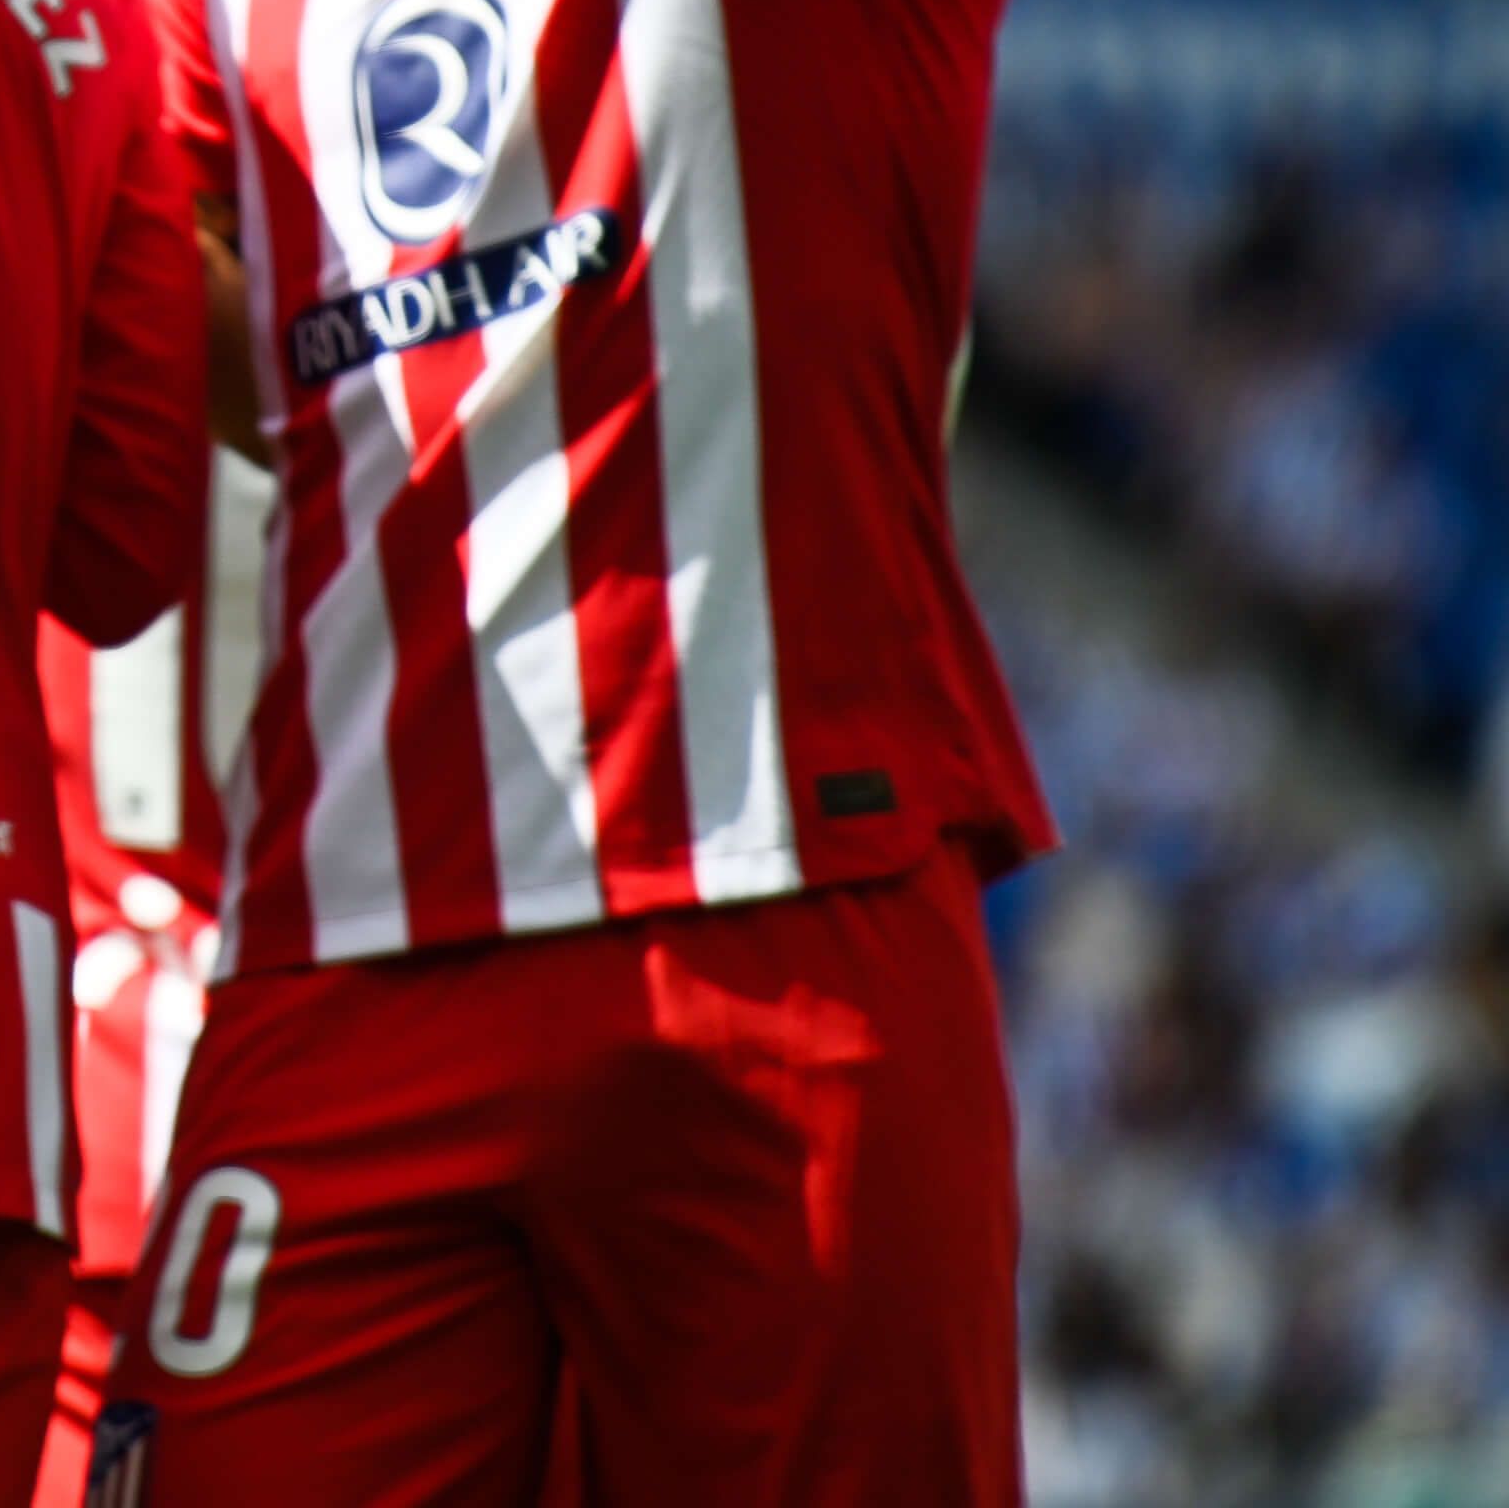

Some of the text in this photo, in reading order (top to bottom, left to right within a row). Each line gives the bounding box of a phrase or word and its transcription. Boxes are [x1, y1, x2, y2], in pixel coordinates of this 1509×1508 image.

[294, 210, 608, 379] RIYADH AIR
[148, 1165, 282, 1378] 0
